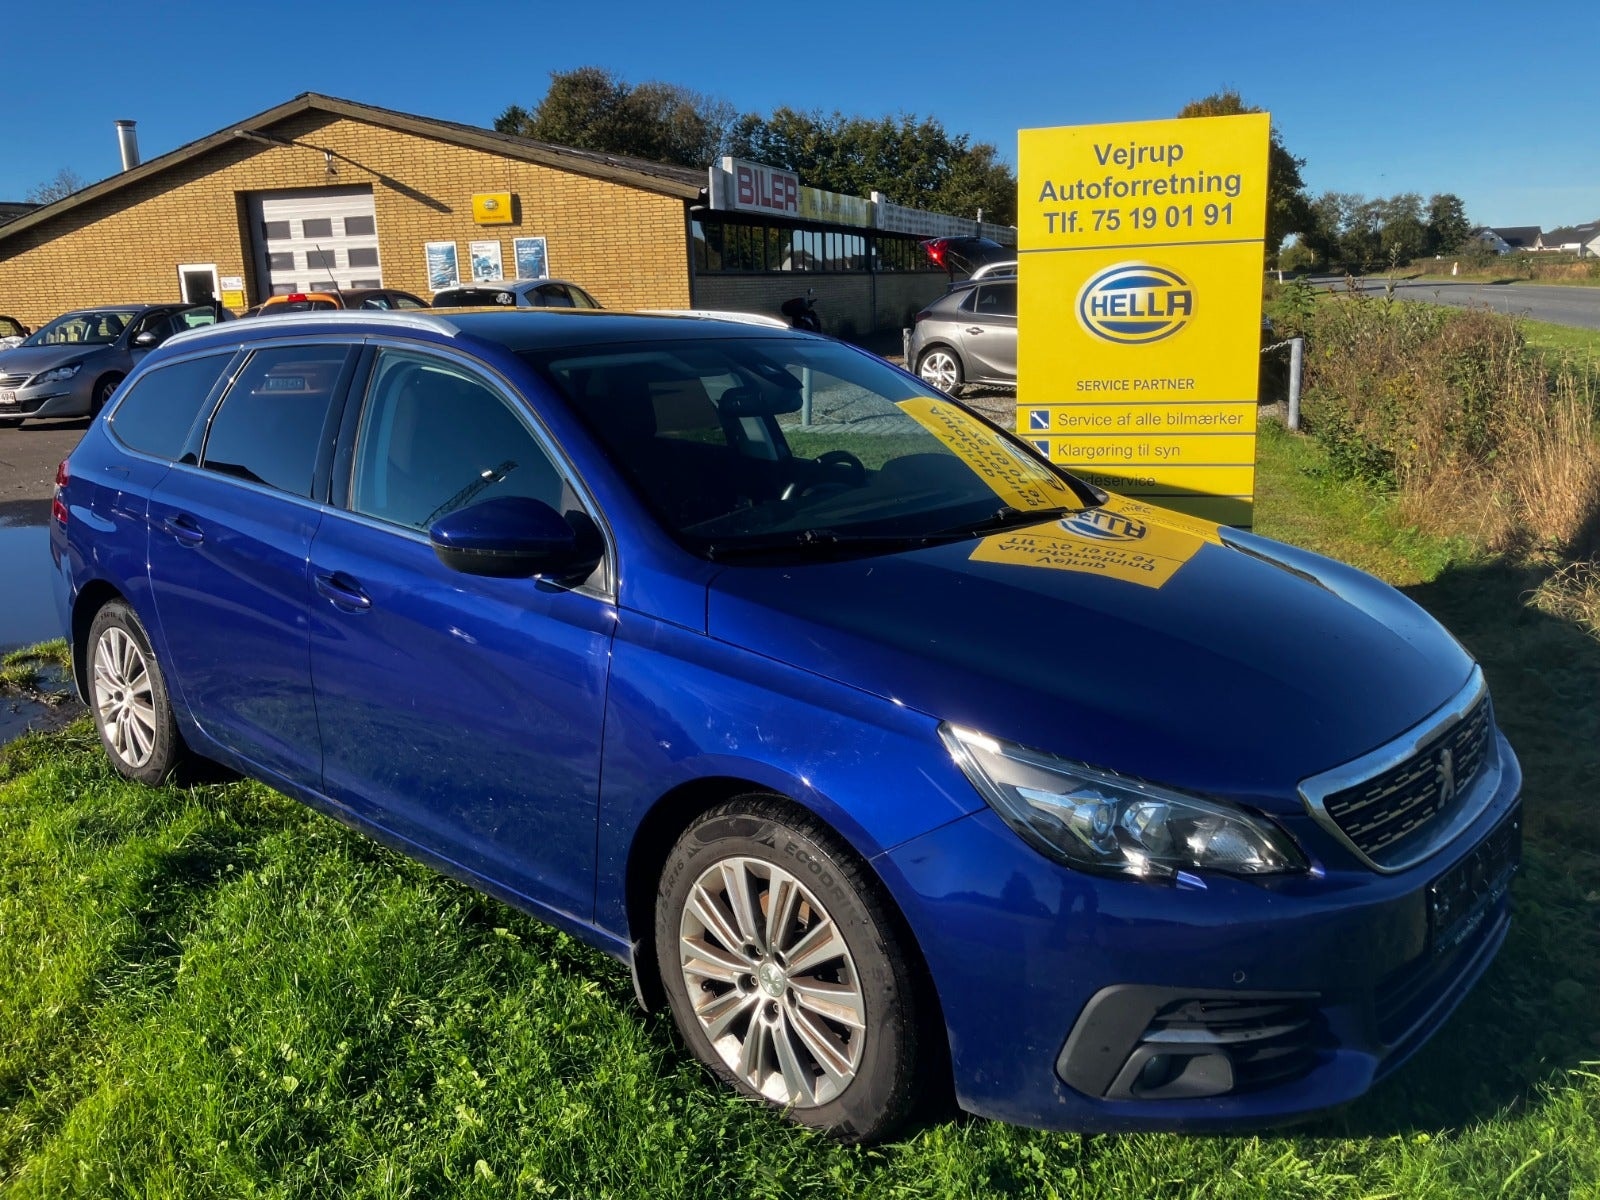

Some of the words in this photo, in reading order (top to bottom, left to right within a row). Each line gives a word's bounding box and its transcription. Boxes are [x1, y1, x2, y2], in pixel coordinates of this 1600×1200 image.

[1093, 141, 1184, 170] Vejrup
[736, 165, 798, 213] BILER
[1038, 170, 1242, 202] Autoforretning
[1043, 211, 1084, 234] Tlf.
[1091, 208, 1121, 231] 75
[1129, 207, 1157, 230] 19
[1165, 204, 1194, 228] 01
[1204, 202, 1233, 226] 91
[1090, 289, 1193, 317] HELLA
[1076, 379, 1130, 391] SERVICE
[1133, 378, 1195, 390] PARTNER
[1057, 412, 1112, 426] Service
[1116, 411, 1131, 426] af
[1135, 411, 1162, 426] alle
[1166, 410, 1244, 425] bilmærker
[1057, 443, 1133, 459] Klargøring
[1137, 443, 1150, 457] til
[1154, 446, 1181, 458] syn
[1082, 473, 1156, 487] deservice
